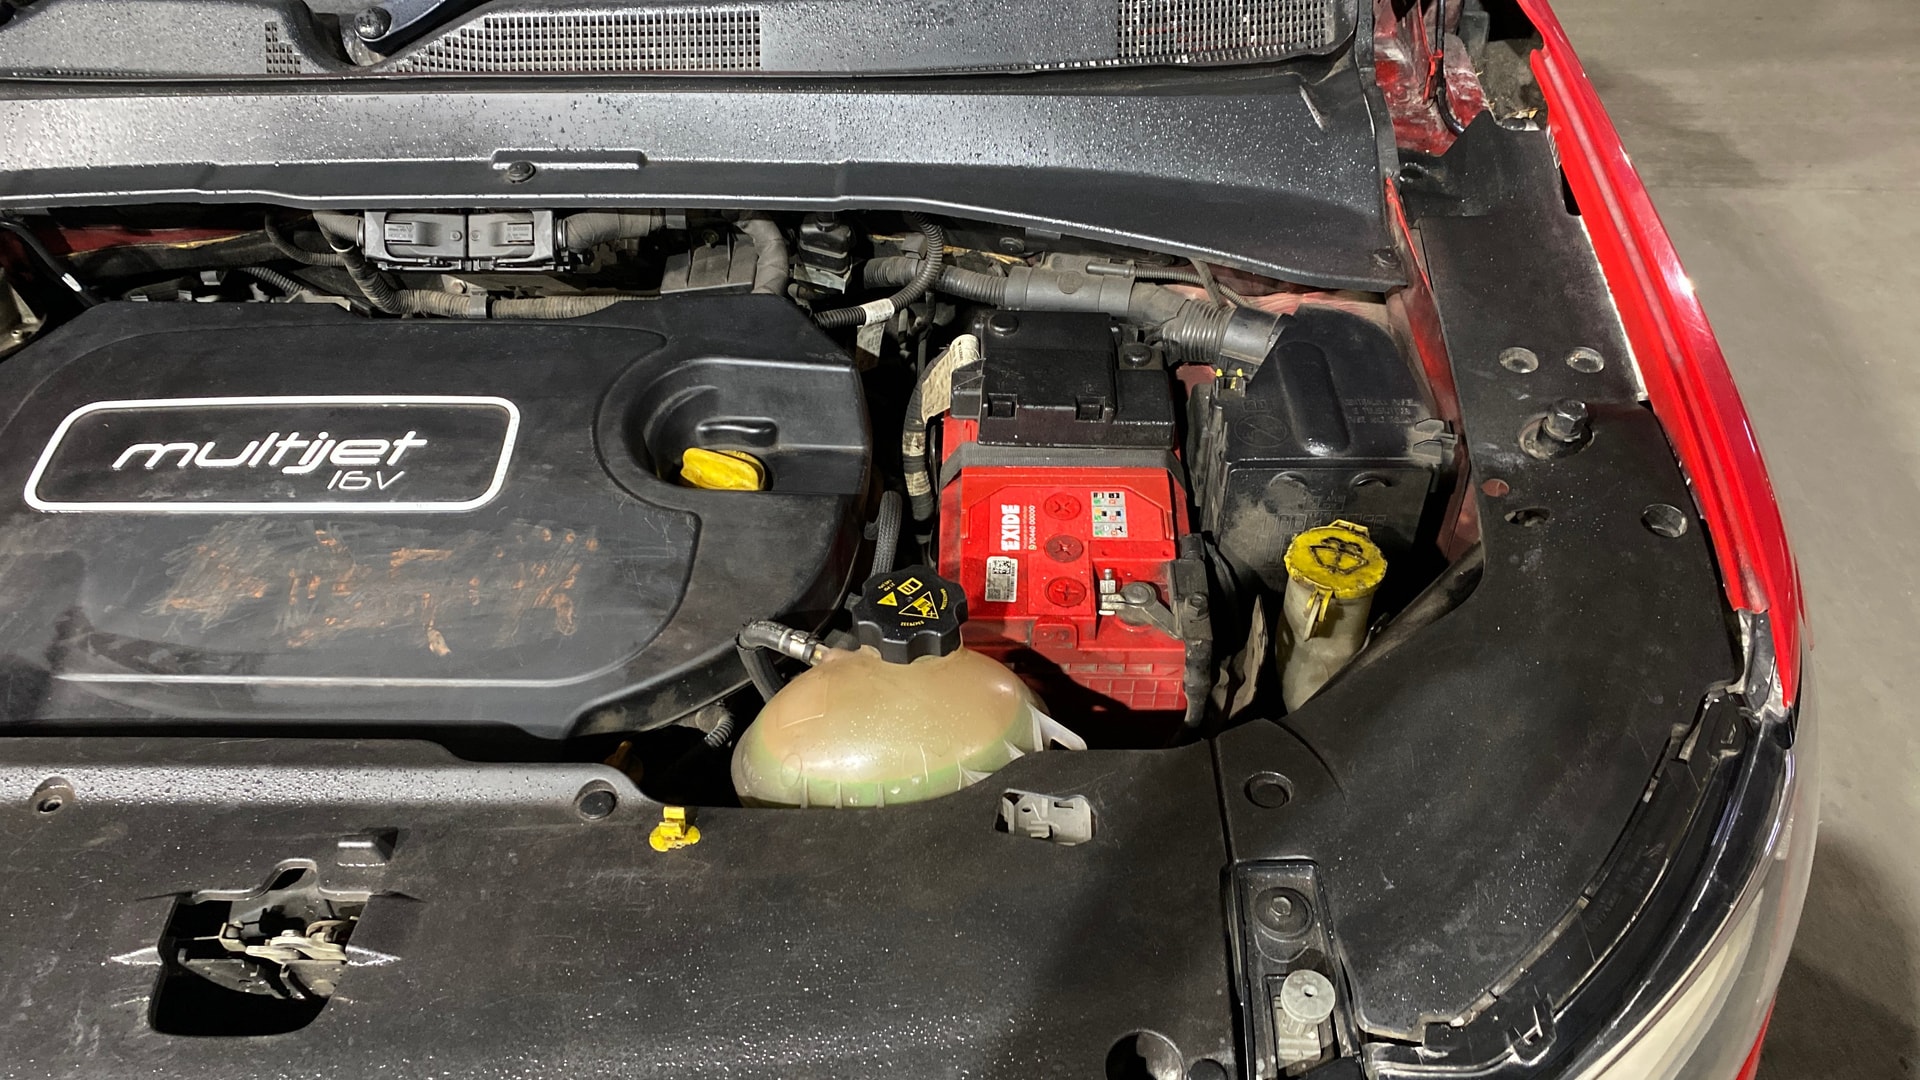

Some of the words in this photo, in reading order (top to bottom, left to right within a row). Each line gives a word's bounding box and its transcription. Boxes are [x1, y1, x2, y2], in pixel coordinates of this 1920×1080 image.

[111, 430, 428, 474] multijet
[327, 470, 405, 491] 16V
[1001, 504, 1020, 551] EXIDE
